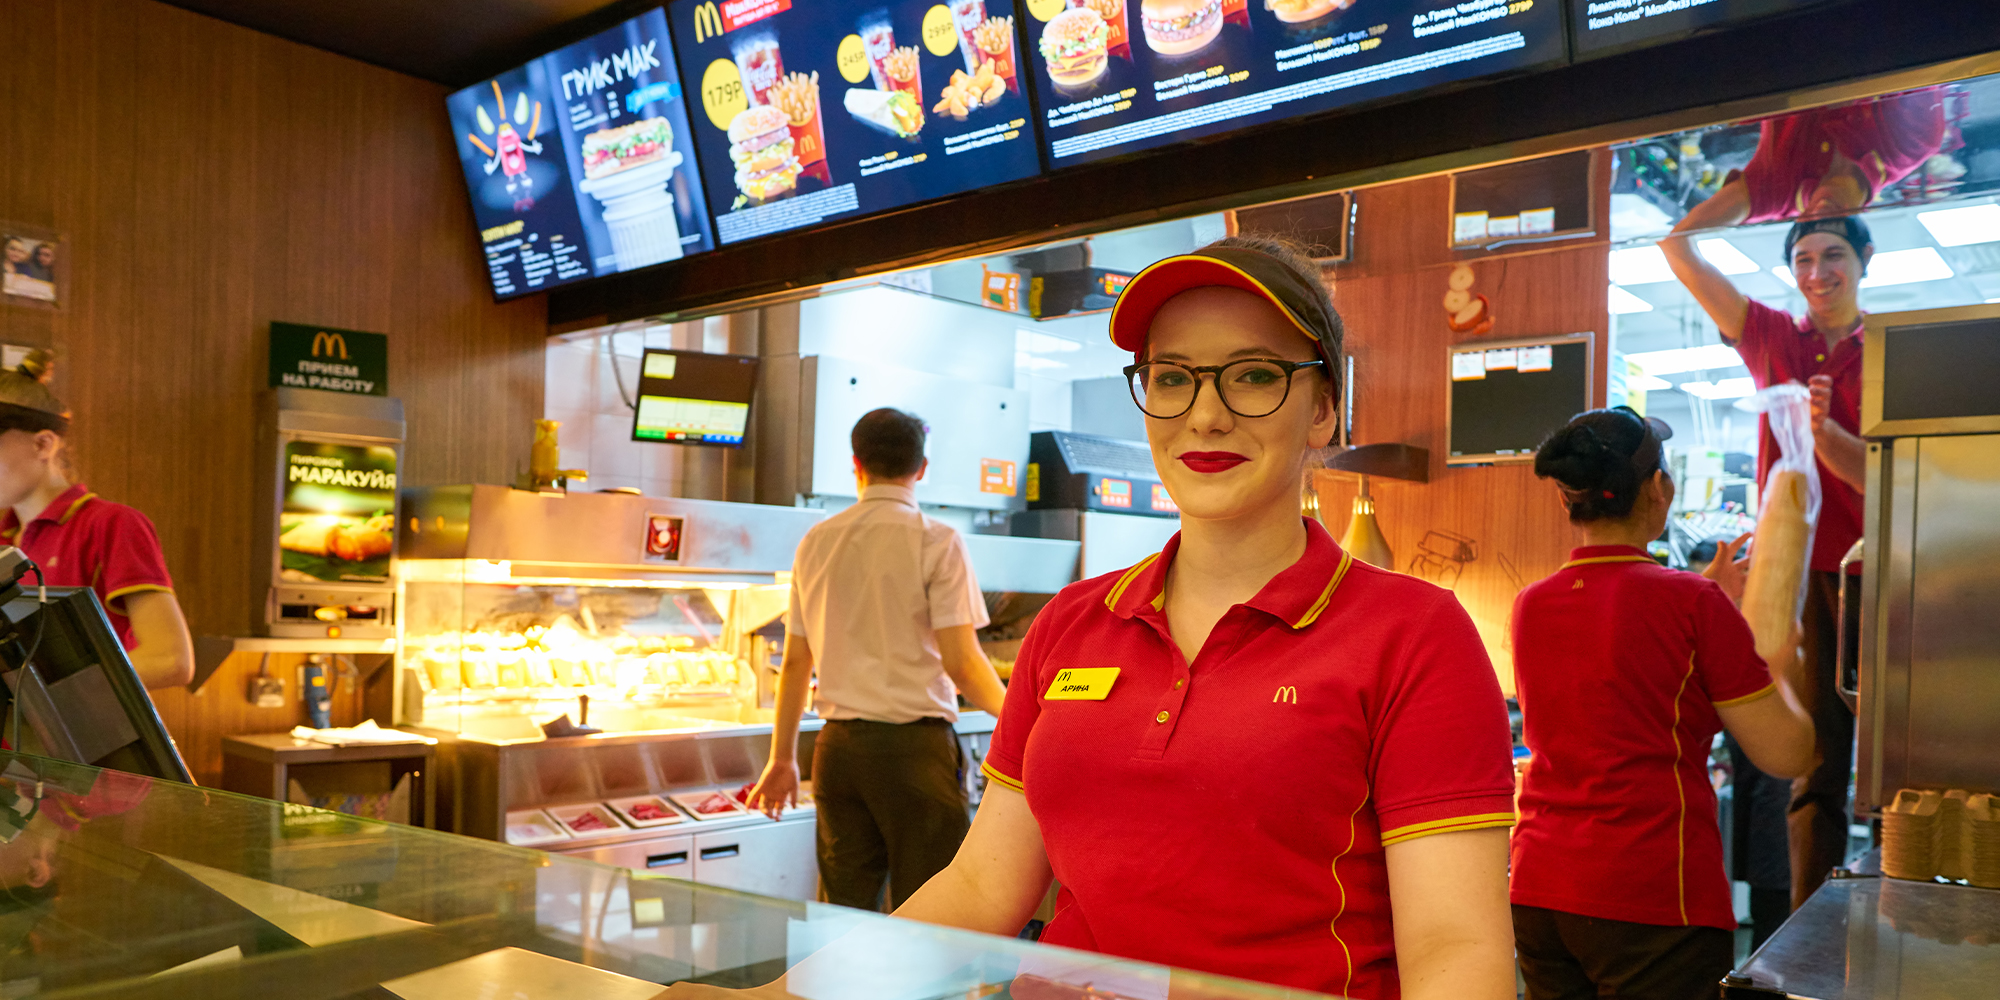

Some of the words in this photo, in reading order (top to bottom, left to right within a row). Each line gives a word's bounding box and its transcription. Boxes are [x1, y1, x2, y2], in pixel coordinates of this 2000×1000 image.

[1413, 19, 1455, 38] Большой
[561, 57, 614, 101] ГРИК
[612, 38, 660, 82] МАК
[299, 361, 359, 378] ПРИЕМ
[282, 374, 306, 387] НА
[309, 376, 374, 394] РАБОТУ
[290, 465, 397, 490] МАРАКУЙЯ
[1060, 684, 1090, 693] АРИНА
